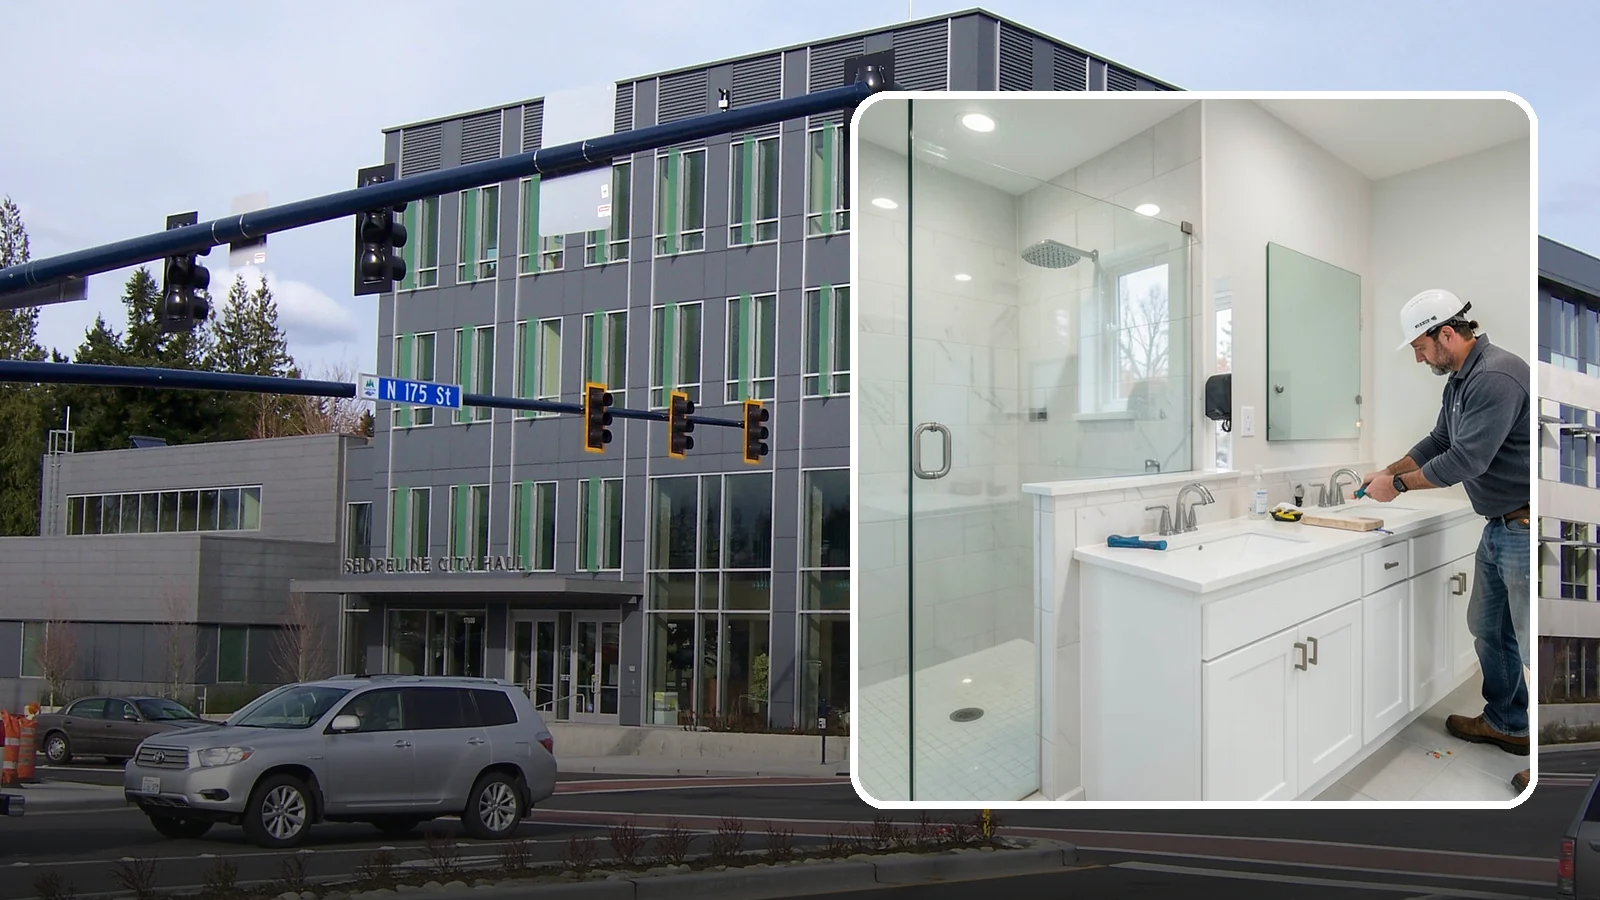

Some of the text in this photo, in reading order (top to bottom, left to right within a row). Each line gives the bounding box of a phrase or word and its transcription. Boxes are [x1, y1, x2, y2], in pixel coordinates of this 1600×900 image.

[387, 380, 451, 406] N 175 St
[344, 555, 525, 574] SHORELINE CITY HALL
